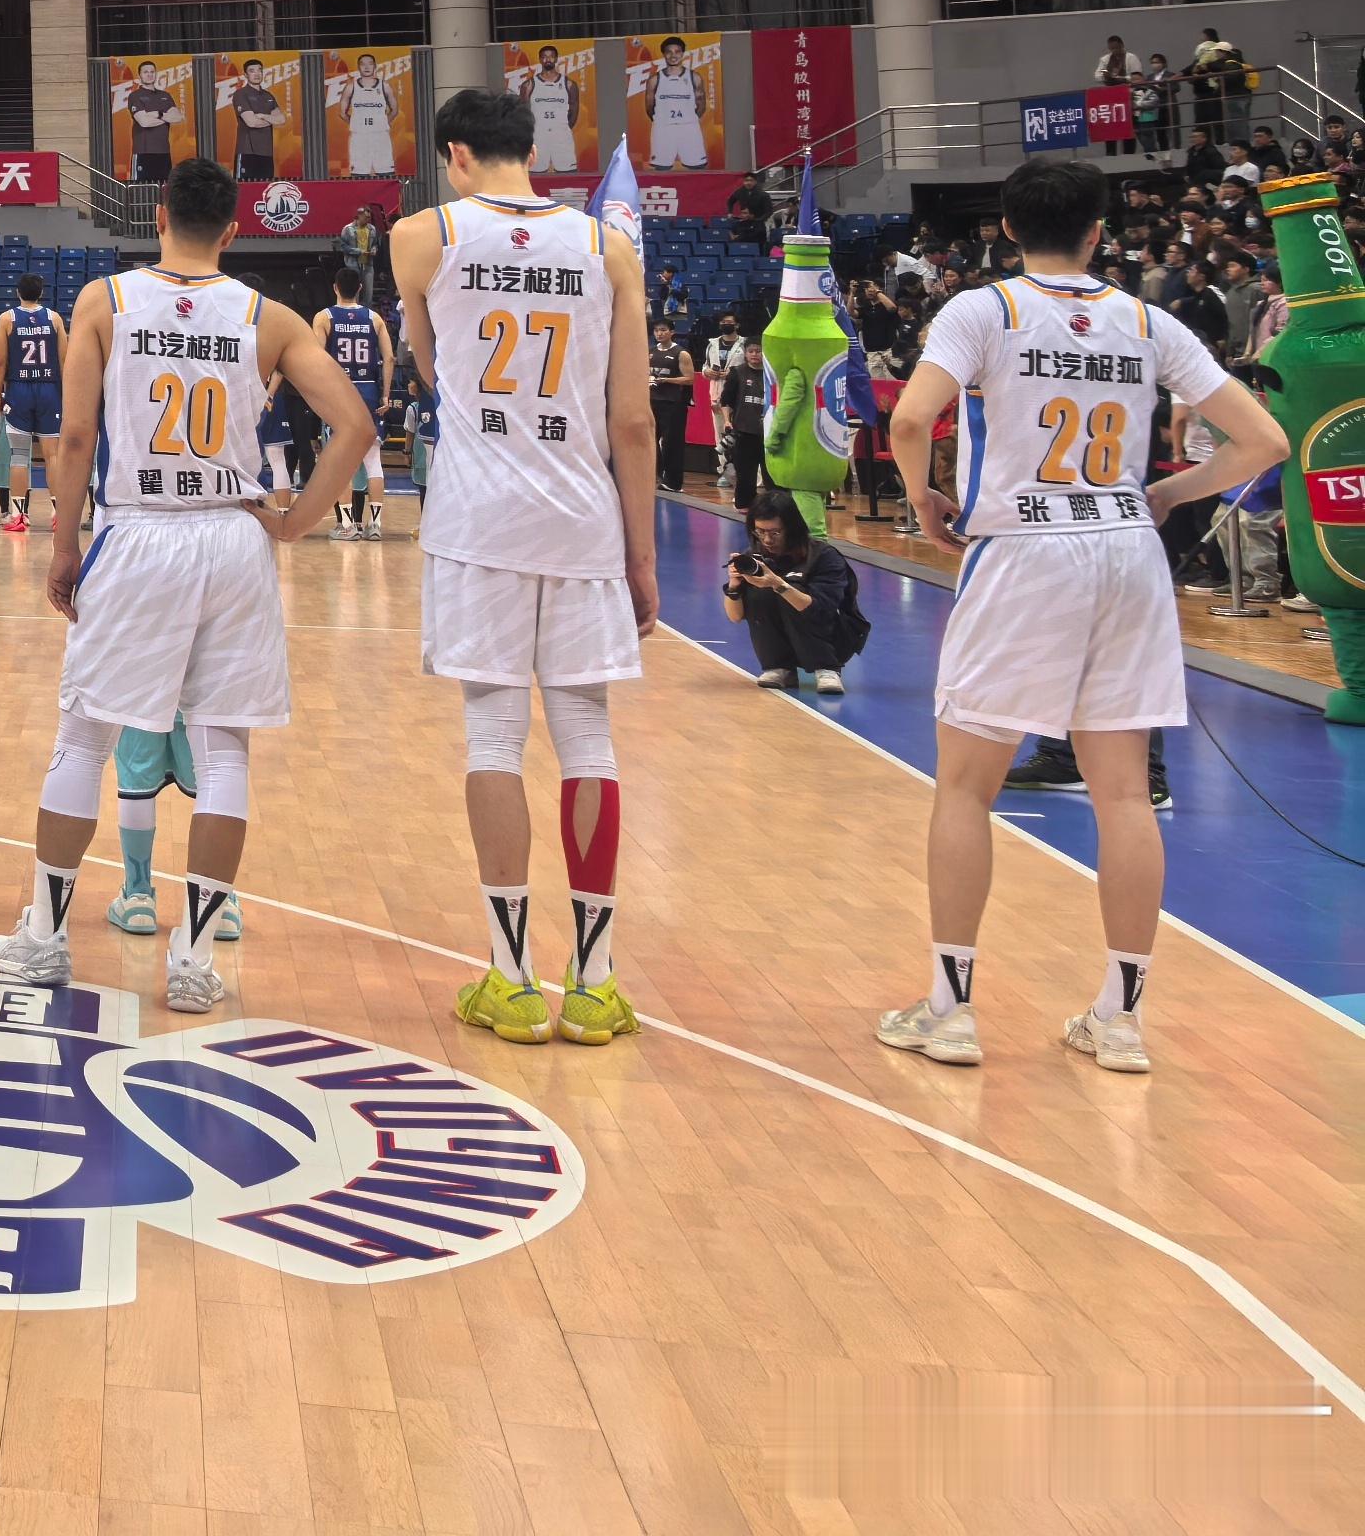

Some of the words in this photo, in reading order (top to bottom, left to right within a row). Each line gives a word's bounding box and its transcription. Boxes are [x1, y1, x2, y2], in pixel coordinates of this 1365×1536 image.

[112, 61, 192, 113] EGLES
[216, 59, 300, 112] EGLES
[325, 56, 411, 108] EGLES
[504, 50, 594, 96] EGLES
[626, 43, 720, 98] EGLES
[794, 32, 812, 154] 青岛胶州湾隧
[670, 109, 683, 118] 24
[1048, 108, 1084, 124] 安全出口
[1055, 125, 1078, 135] EXIT
[1089, 103, 1127, 124] 8号门
[264, 217, 301, 233] QINGDAO
[1312, 213, 1354, 276] 1903
[461, 263, 585, 298] 北汽极狐
[21, 340, 47, 364] 21
[130, 328, 242, 364] 北汽极狐
[338, 338, 369, 364] 36
[479, 309, 571, 399] 27
[1019, 347, 1145, 385] 北汽极狐
[149, 371, 227, 458] 20
[480, 407, 569, 442] 周琦
[1038, 396, 1128, 487] 28
[137, 468, 243, 497] 翟晓川
[202, 1030, 562, 1268] QINGDAO
